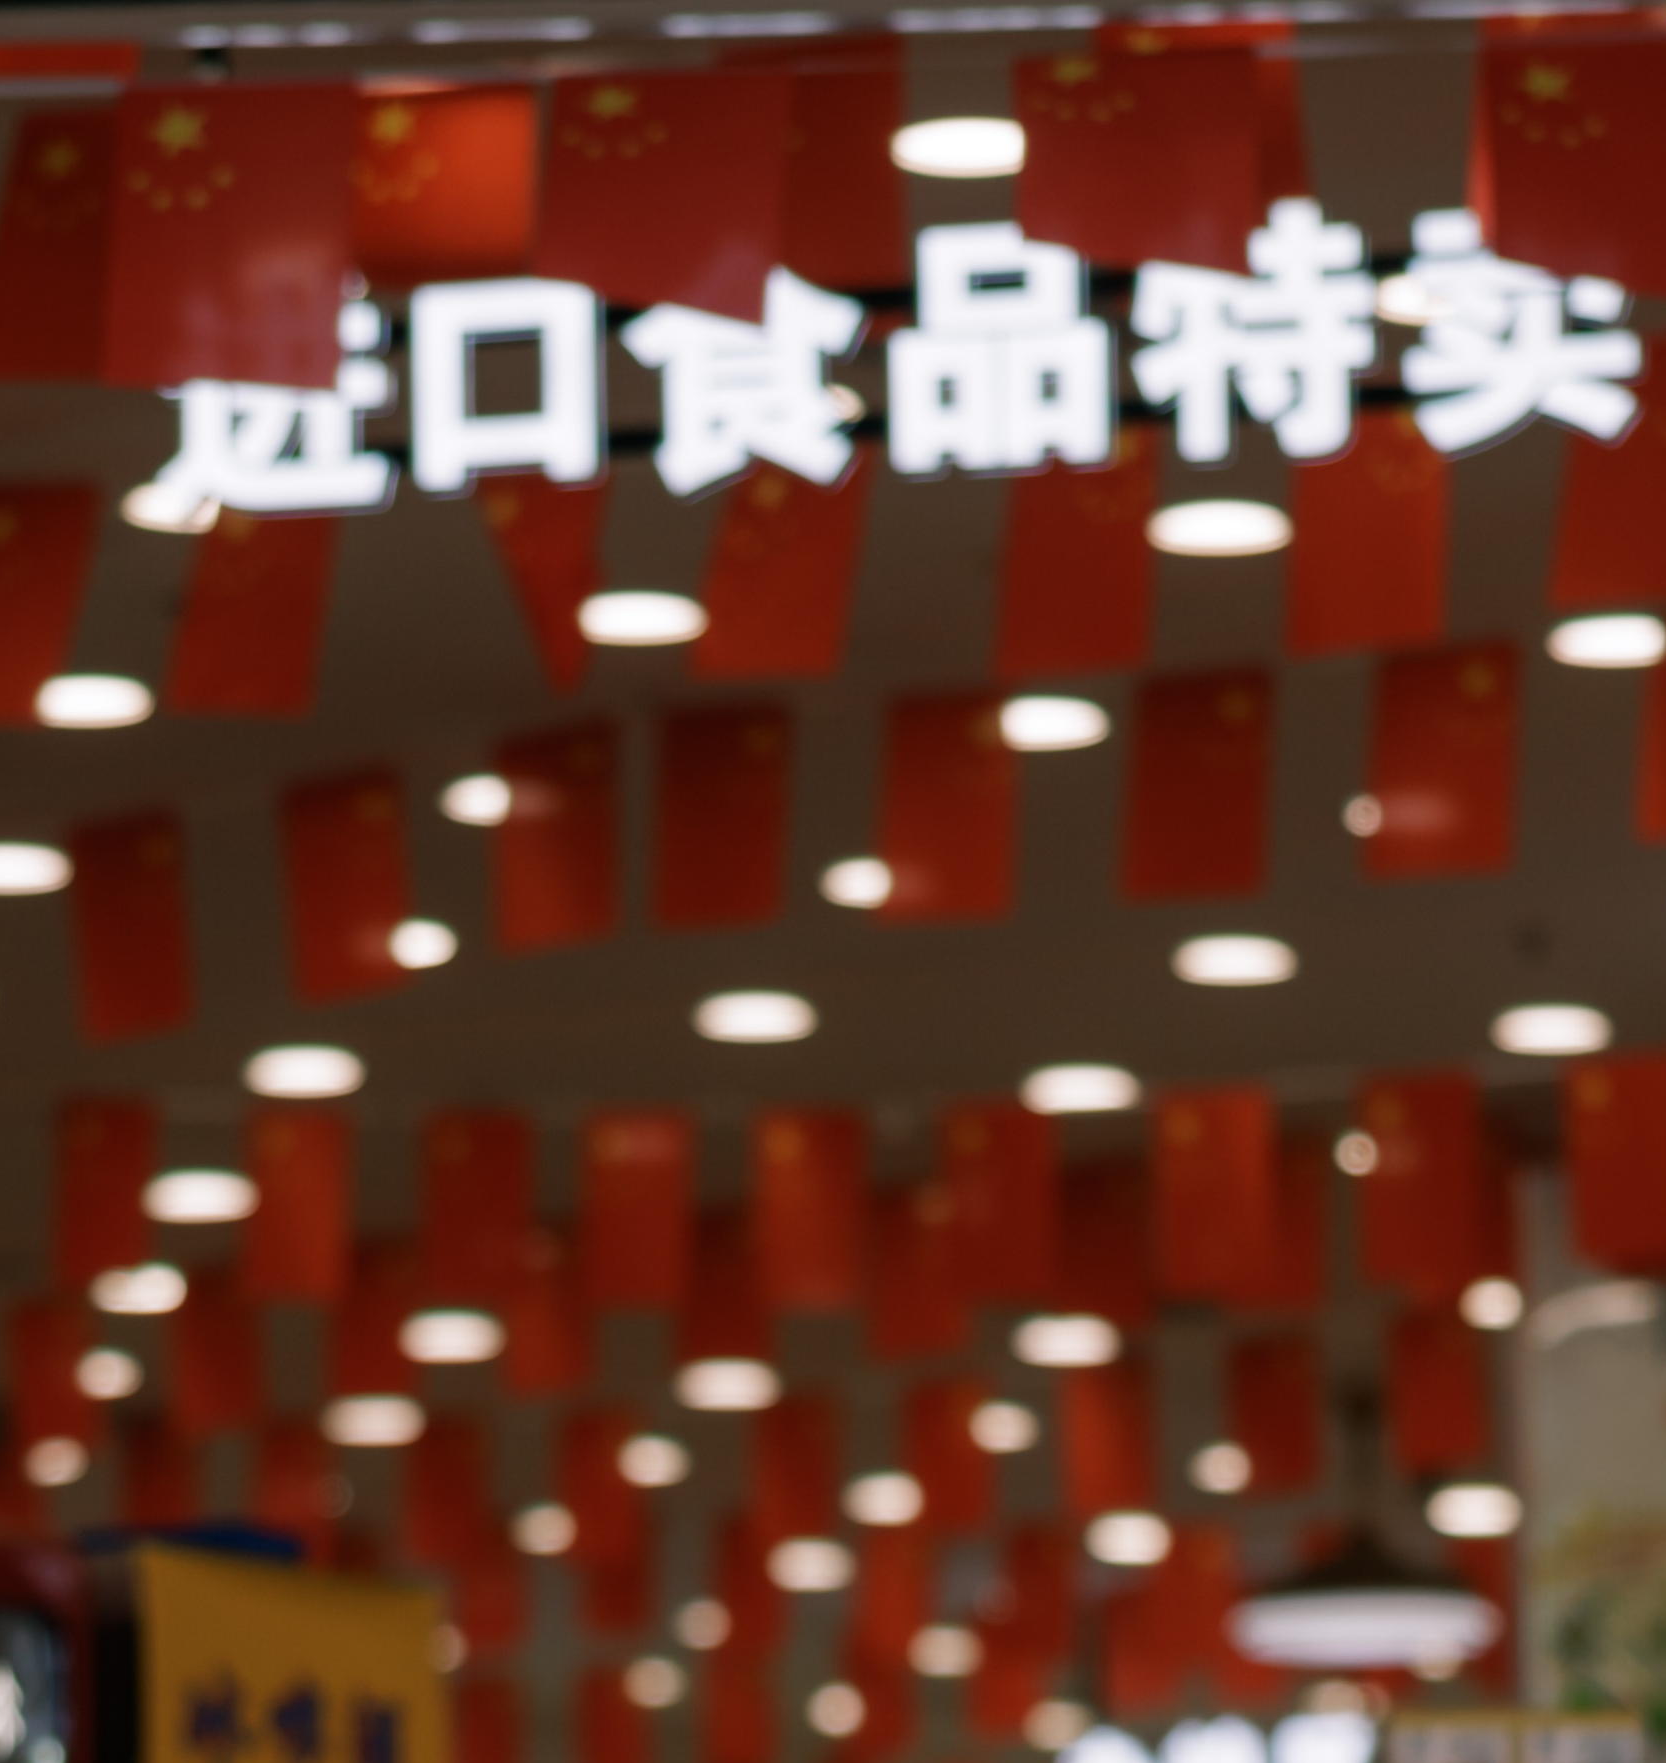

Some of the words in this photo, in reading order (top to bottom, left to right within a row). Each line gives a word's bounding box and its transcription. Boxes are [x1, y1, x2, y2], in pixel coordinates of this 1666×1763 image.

[161, 198, 1643, 514] 进口食品特卖
